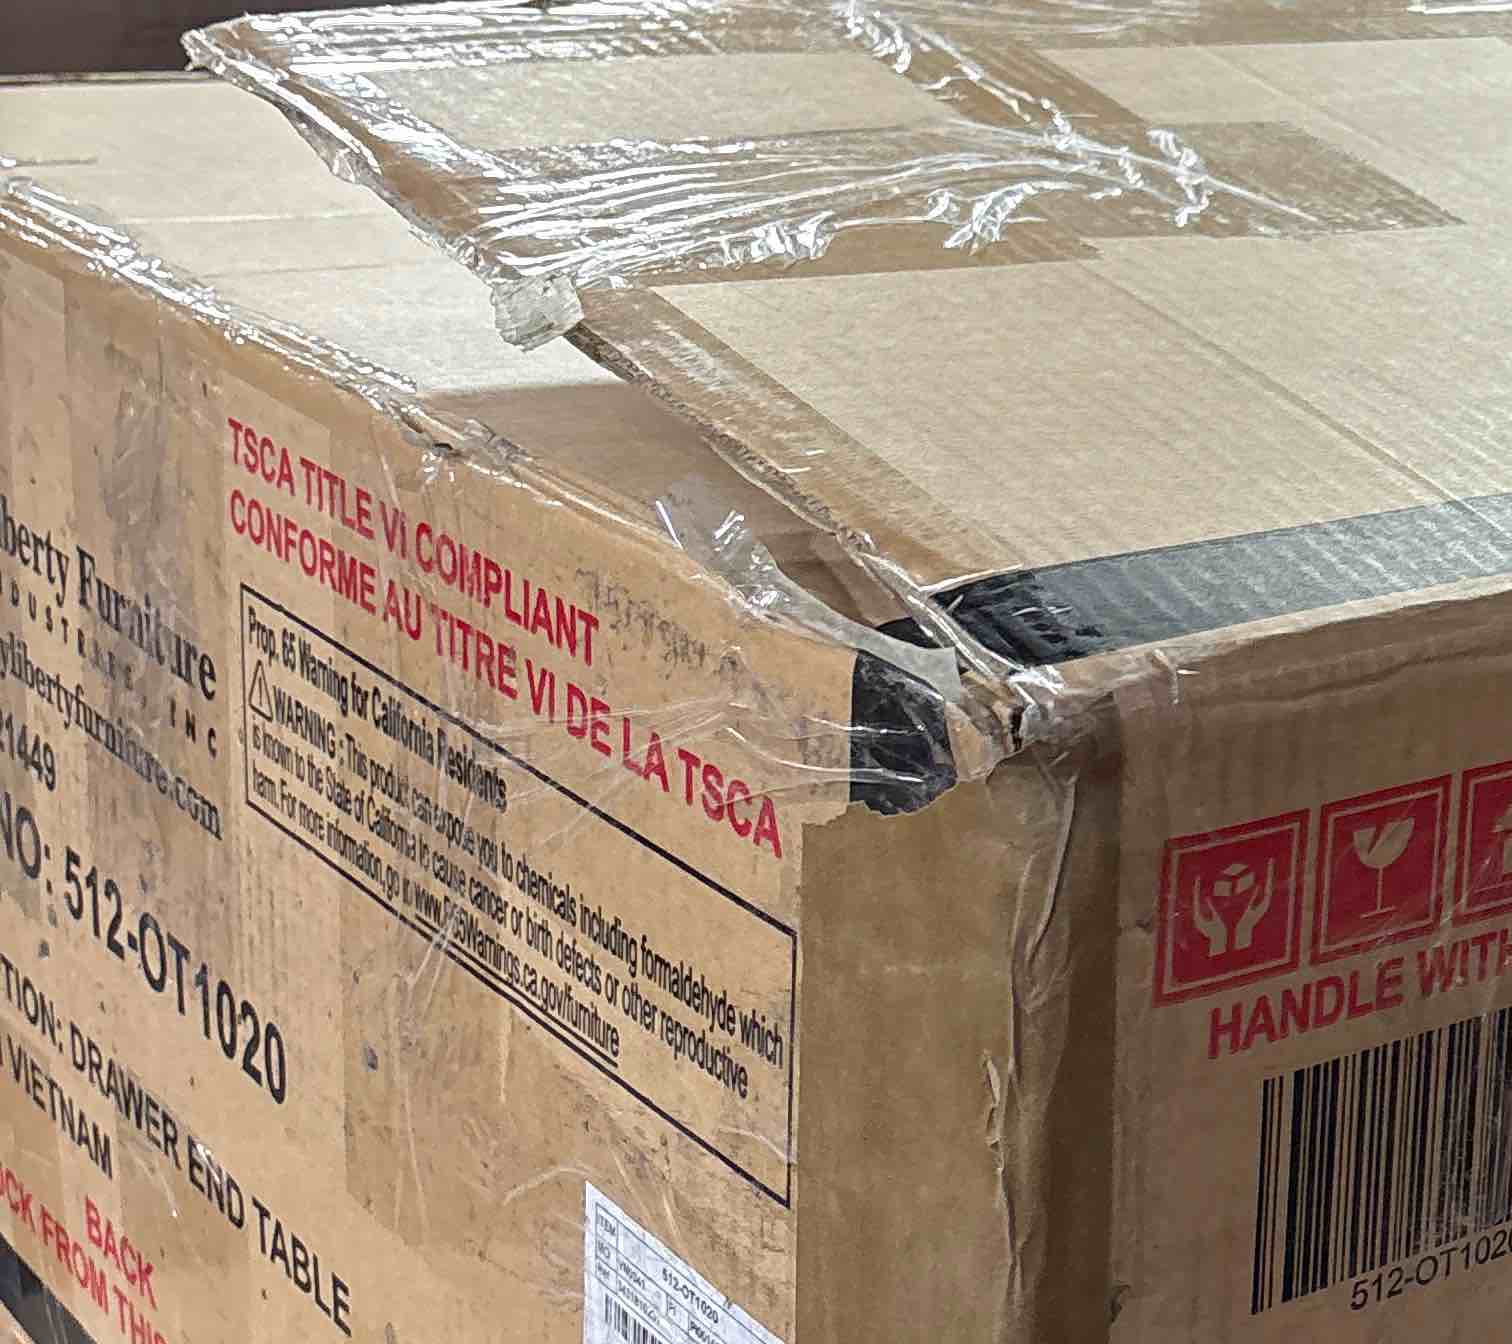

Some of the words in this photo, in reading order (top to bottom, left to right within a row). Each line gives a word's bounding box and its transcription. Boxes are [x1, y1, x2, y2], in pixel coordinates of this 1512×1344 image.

[228, 417, 296, 497] TSCA
[299, 456, 375, 541] TITLE
[380, 501, 407, 560] VI
[415, 522, 600, 667] COMPLIANT
[230, 488, 377, 616] CONFORME
[383, 578, 423, 641] AU
[430, 604, 519, 702] TITRE
[525, 658, 555, 724] VI
[566, 682, 612, 757] DE
[623, 717, 670, 793] LA
[677, 747, 783, 859] TSCA
[248, 604, 279, 671] Prop.
[281, 625, 296, 674] 65
[298, 635, 348, 719] Warning
[350, 670, 369, 723] for
[371, 683, 434, 767] California
[64, 845, 287, 1106] 512-OT1020
[272, 682, 336, 761] WARNING
[345, 731, 367, 781] This
[501, 842, 512, 884] to
[516, 852, 576, 929] chemicals
[579, 892, 637, 980] including
[640, 933, 736, 1041] formaldehyde
[739, 1005, 784, 1073] which
[325, 763, 351, 818] State
[468, 871, 509, 931] cancer
[511, 903, 523, 942] or
[525, 904, 553, 963] birth
[556, 926, 602, 998] defects
[605, 969, 619, 1011] or
[621, 975, 658, 1038] other
[660, 1007, 749, 1104] reproductive
[6, 1032, 114, 1180] VIETNAM
[1207, 956, 1406, 1060] HANDLE
[40, 1203, 110, 1316] FROM
[70, 1020, 181, 1171] DRAWER
[188, 1133, 246, 1230] END
[252, 1195, 352, 1338] TABLE
[85, 1195, 159, 1312] BACK
[662, 1265, 718, 1327] 512-OT1020
